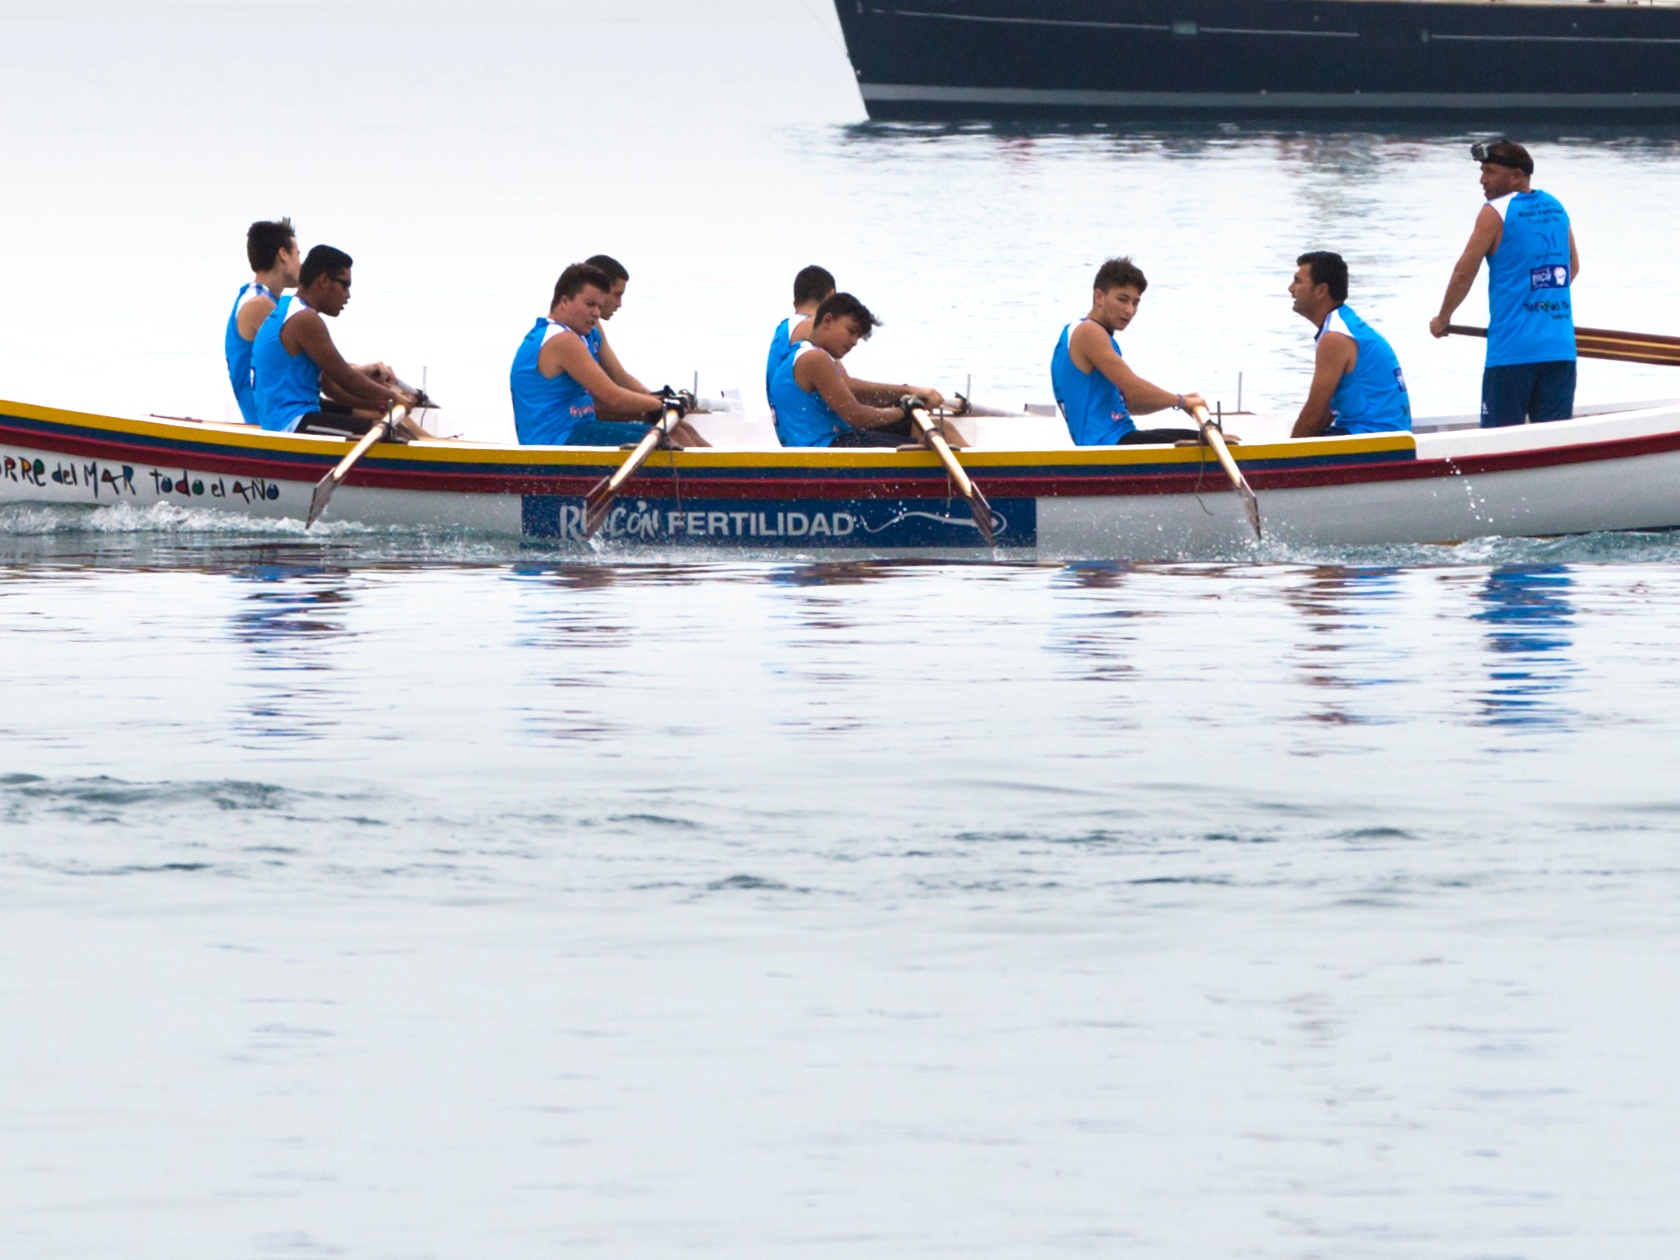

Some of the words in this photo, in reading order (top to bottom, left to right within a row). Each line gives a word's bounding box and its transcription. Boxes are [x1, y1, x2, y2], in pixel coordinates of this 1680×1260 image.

[51, 462, 78, 486] del
[83, 460, 137, 499] MAR
[211, 477, 226, 498] el
[668, 510, 854, 537] FERTILIDAD
